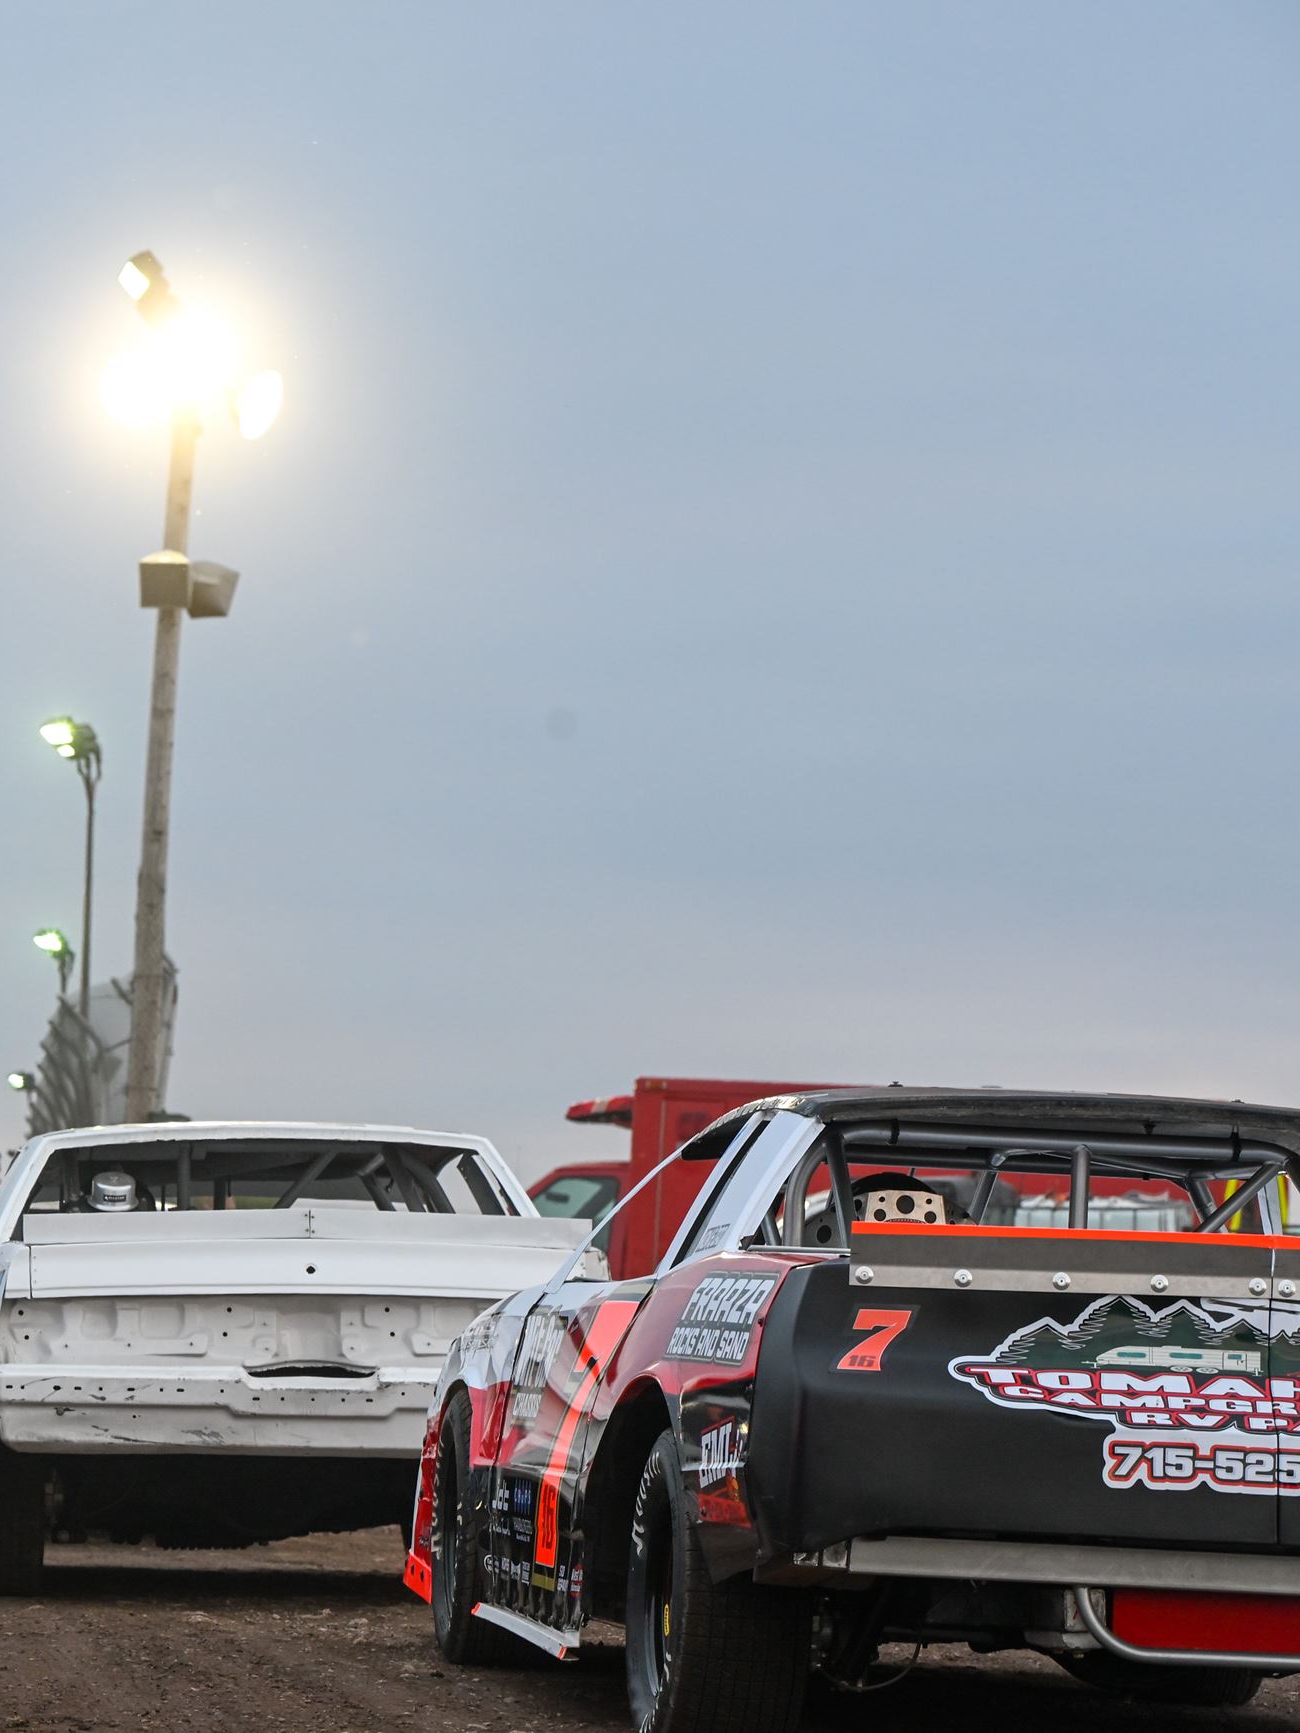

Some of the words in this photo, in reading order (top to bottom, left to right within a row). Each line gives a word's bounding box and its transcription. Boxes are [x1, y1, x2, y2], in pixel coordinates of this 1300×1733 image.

[665, 1327, 702, 1356] ROCKS
[693, 1328, 721, 1358] AND
[715, 1330, 750, 1361] SAND
[836, 1308, 913, 1372] 7
[848, 1354, 876, 1368] 16
[1129, 1411, 1226, 1427] RV
[1248, 1416, 1300, 1432] P
[1112, 1446, 1300, 1484] 715-525
